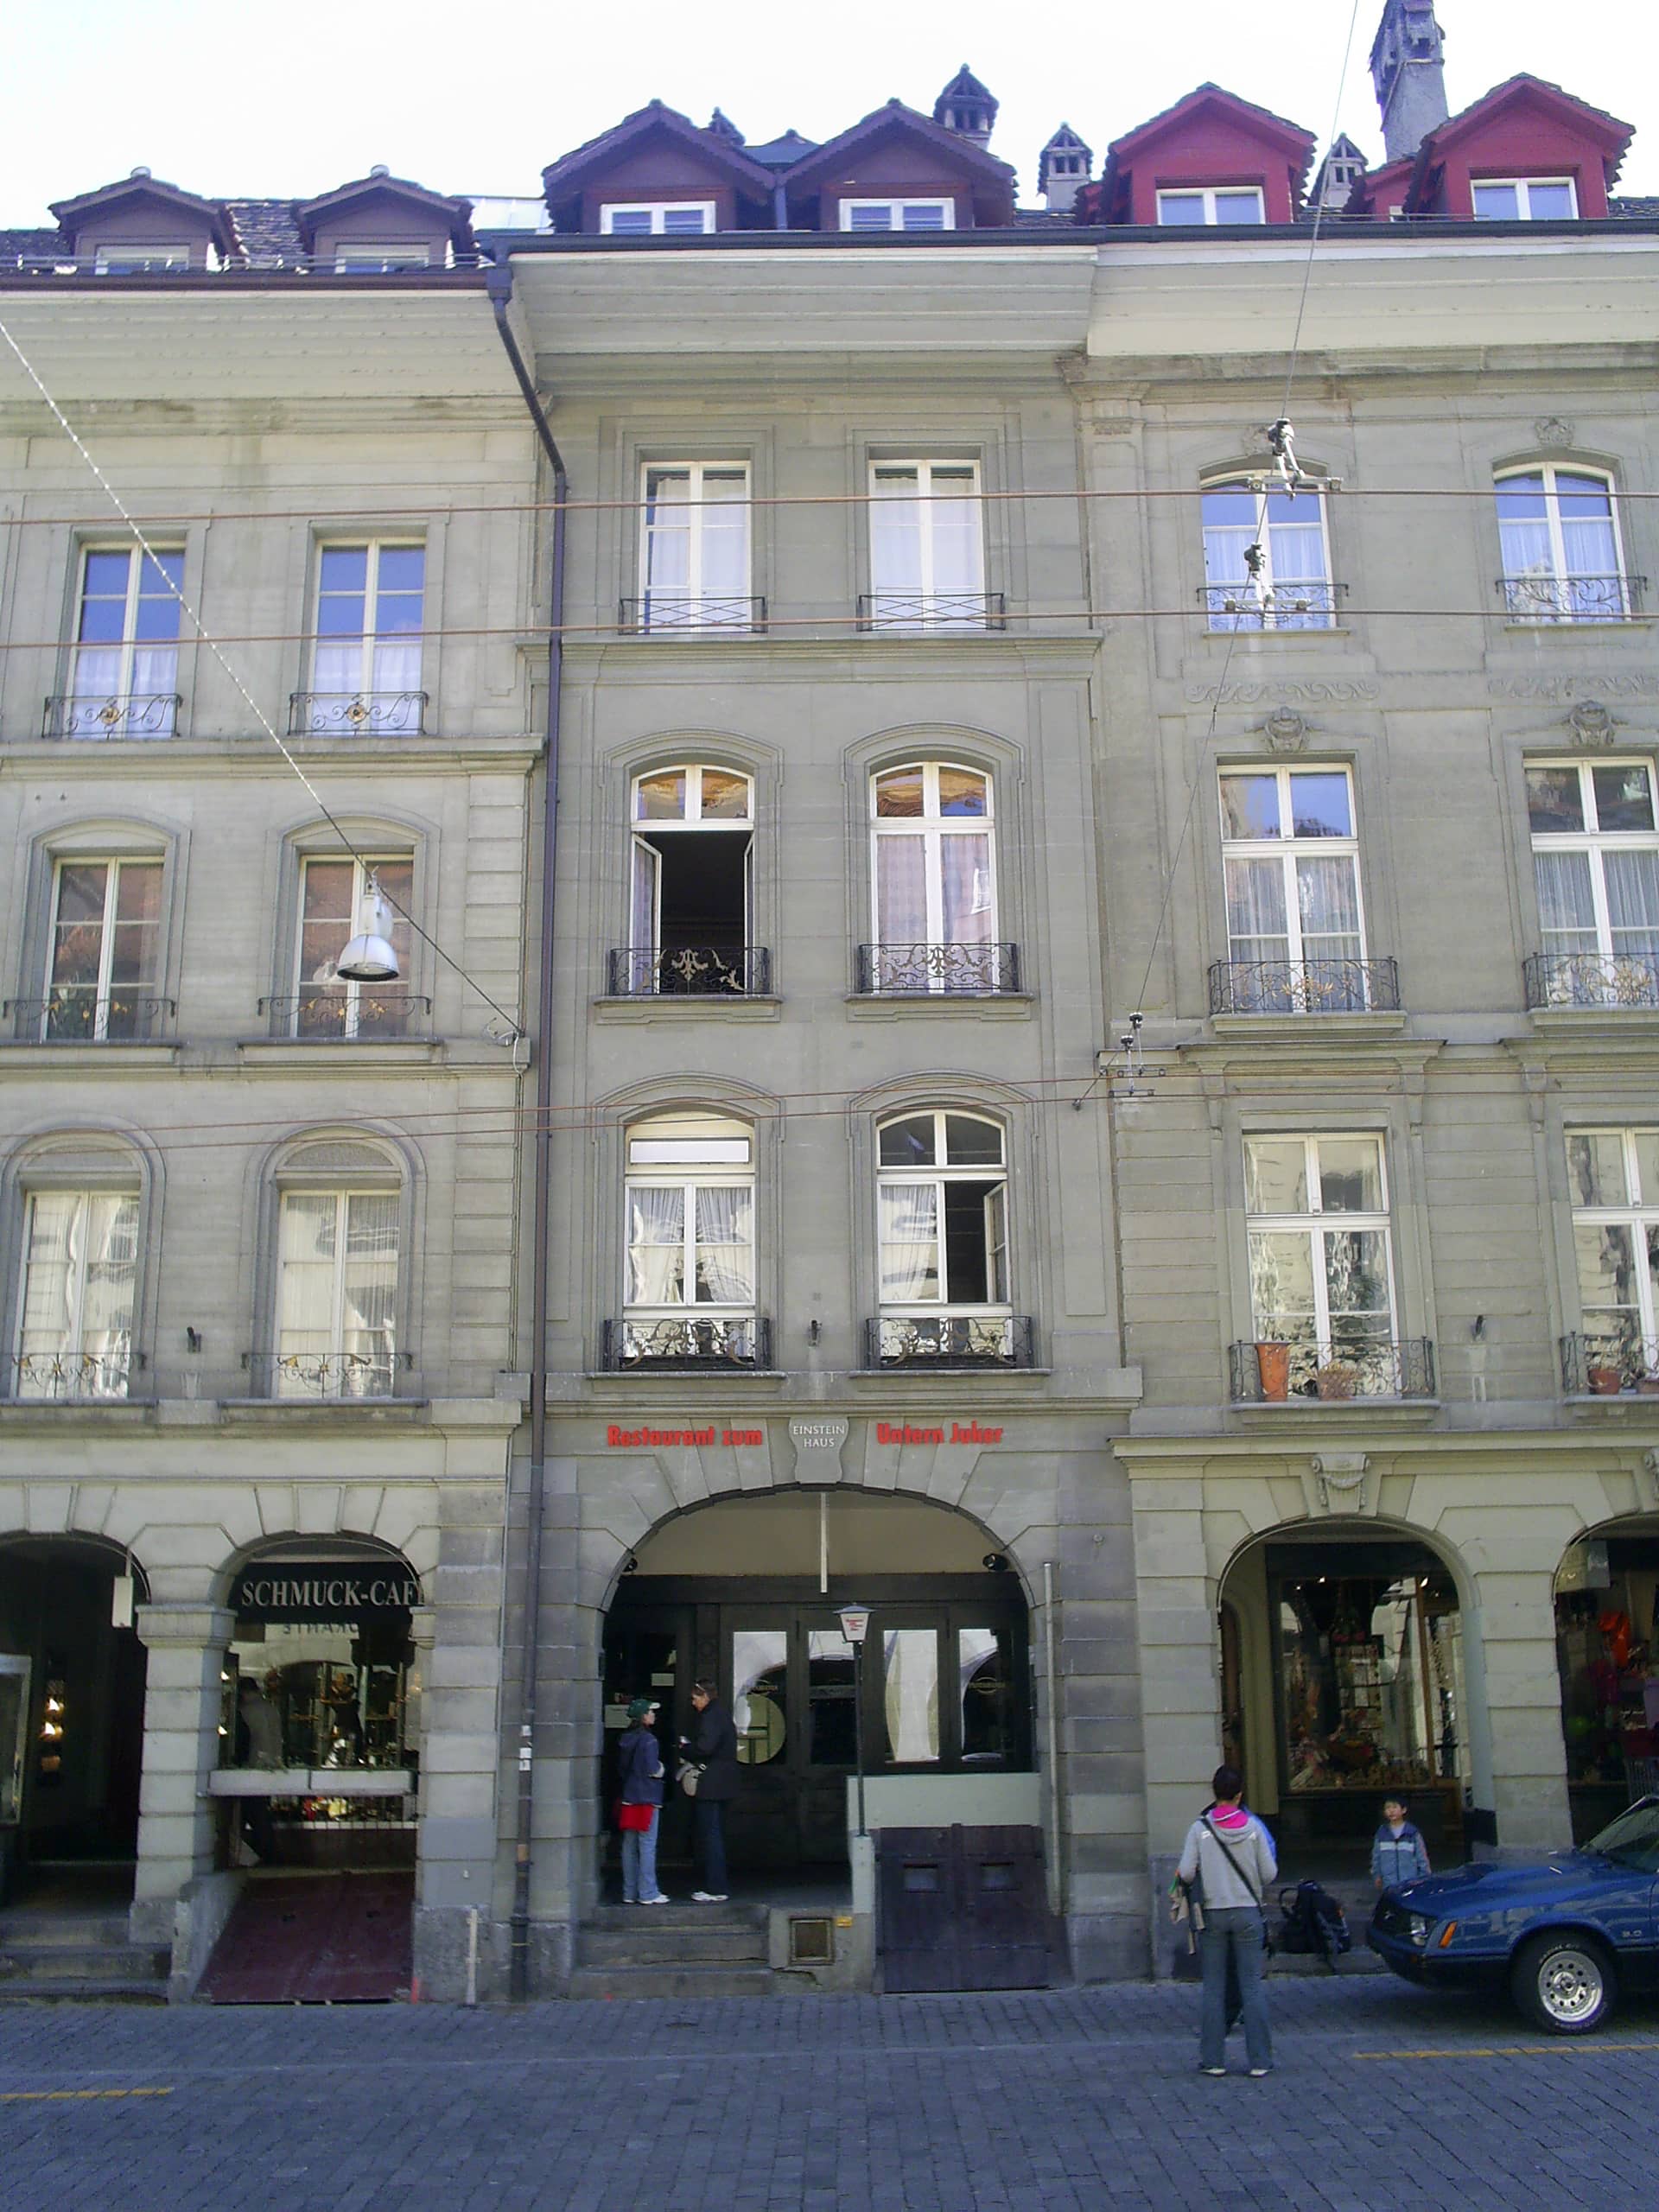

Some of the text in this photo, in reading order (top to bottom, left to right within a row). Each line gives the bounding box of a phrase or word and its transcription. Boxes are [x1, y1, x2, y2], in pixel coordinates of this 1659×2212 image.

[607, 1425, 763, 1446] Restaurant zum
[793, 1425, 845, 1435] EINSTEIN
[876, 1419, 1003, 1446] Untern Juker
[804, 1438, 835, 1447] HAUS
